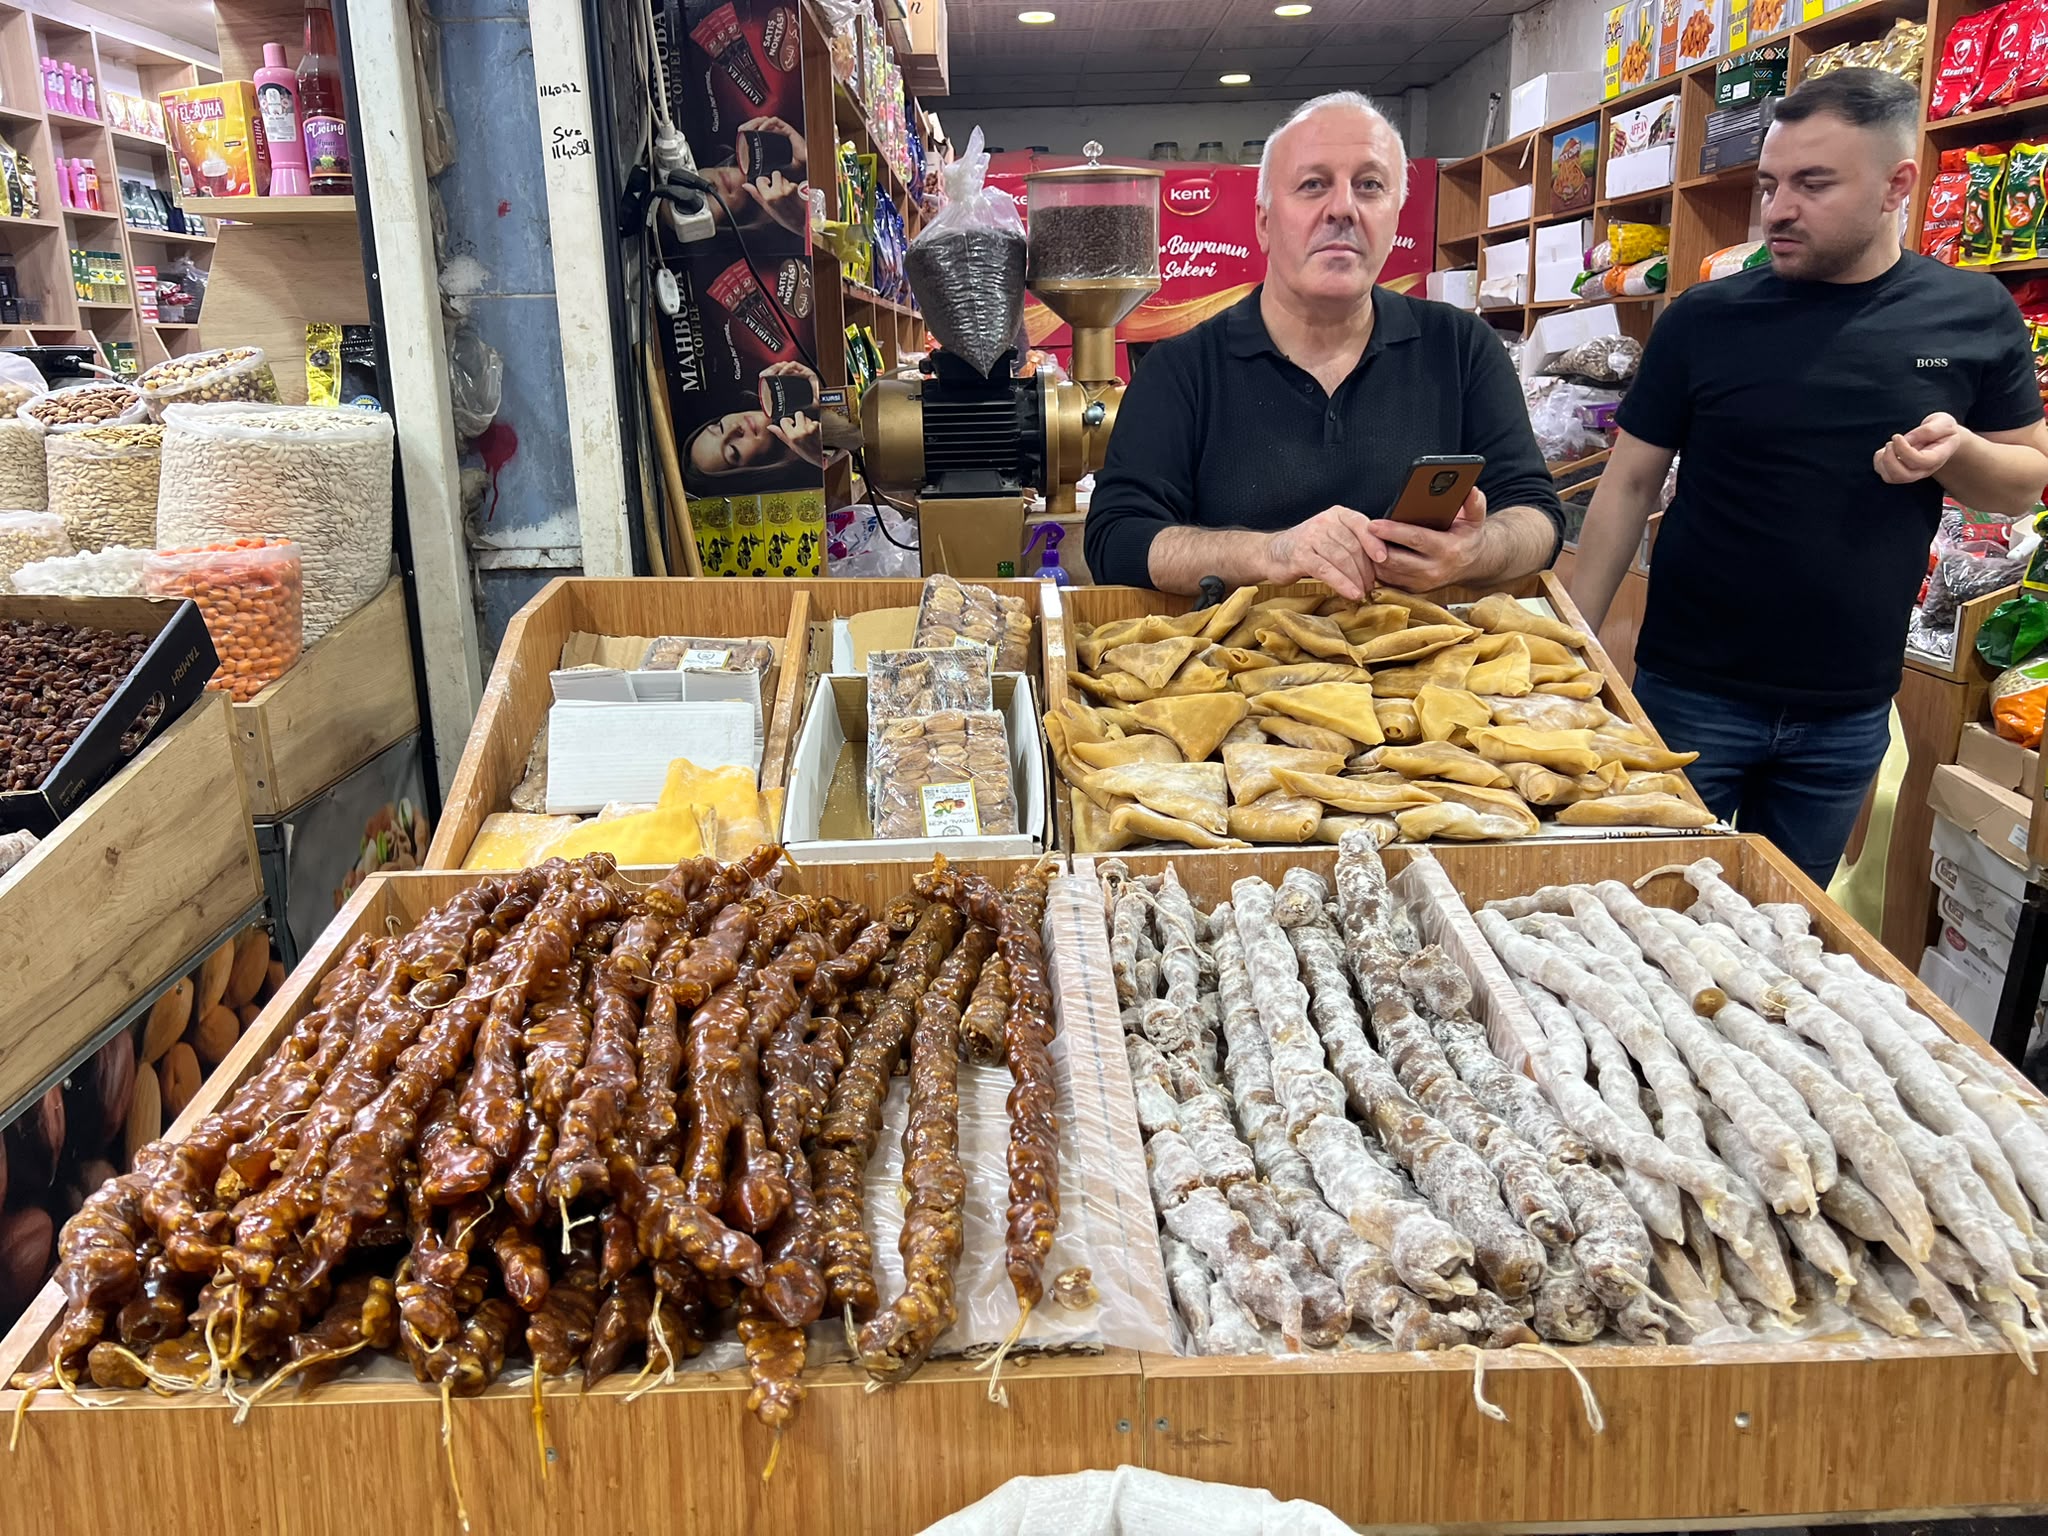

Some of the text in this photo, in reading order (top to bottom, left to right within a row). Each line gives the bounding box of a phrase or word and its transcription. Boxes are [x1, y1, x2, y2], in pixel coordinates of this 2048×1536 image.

[769, 13, 784, 57] NOKTASI
[670, 47, 683, 104] COFFEE
[178, 101, 223, 121] EL-RUHA
[253, 119, 266, 160] EL-RUHA
[1170, 187, 1211, 201] kent
[1167, 234, 1250, 262] Bayramın
[783, 264, 796, 306] NOKTASI
[1162, 260, 1217, 282] Şekeri
[690, 304, 705, 358] COFFEE
[1916, 358, 1949, 368] BOSS
